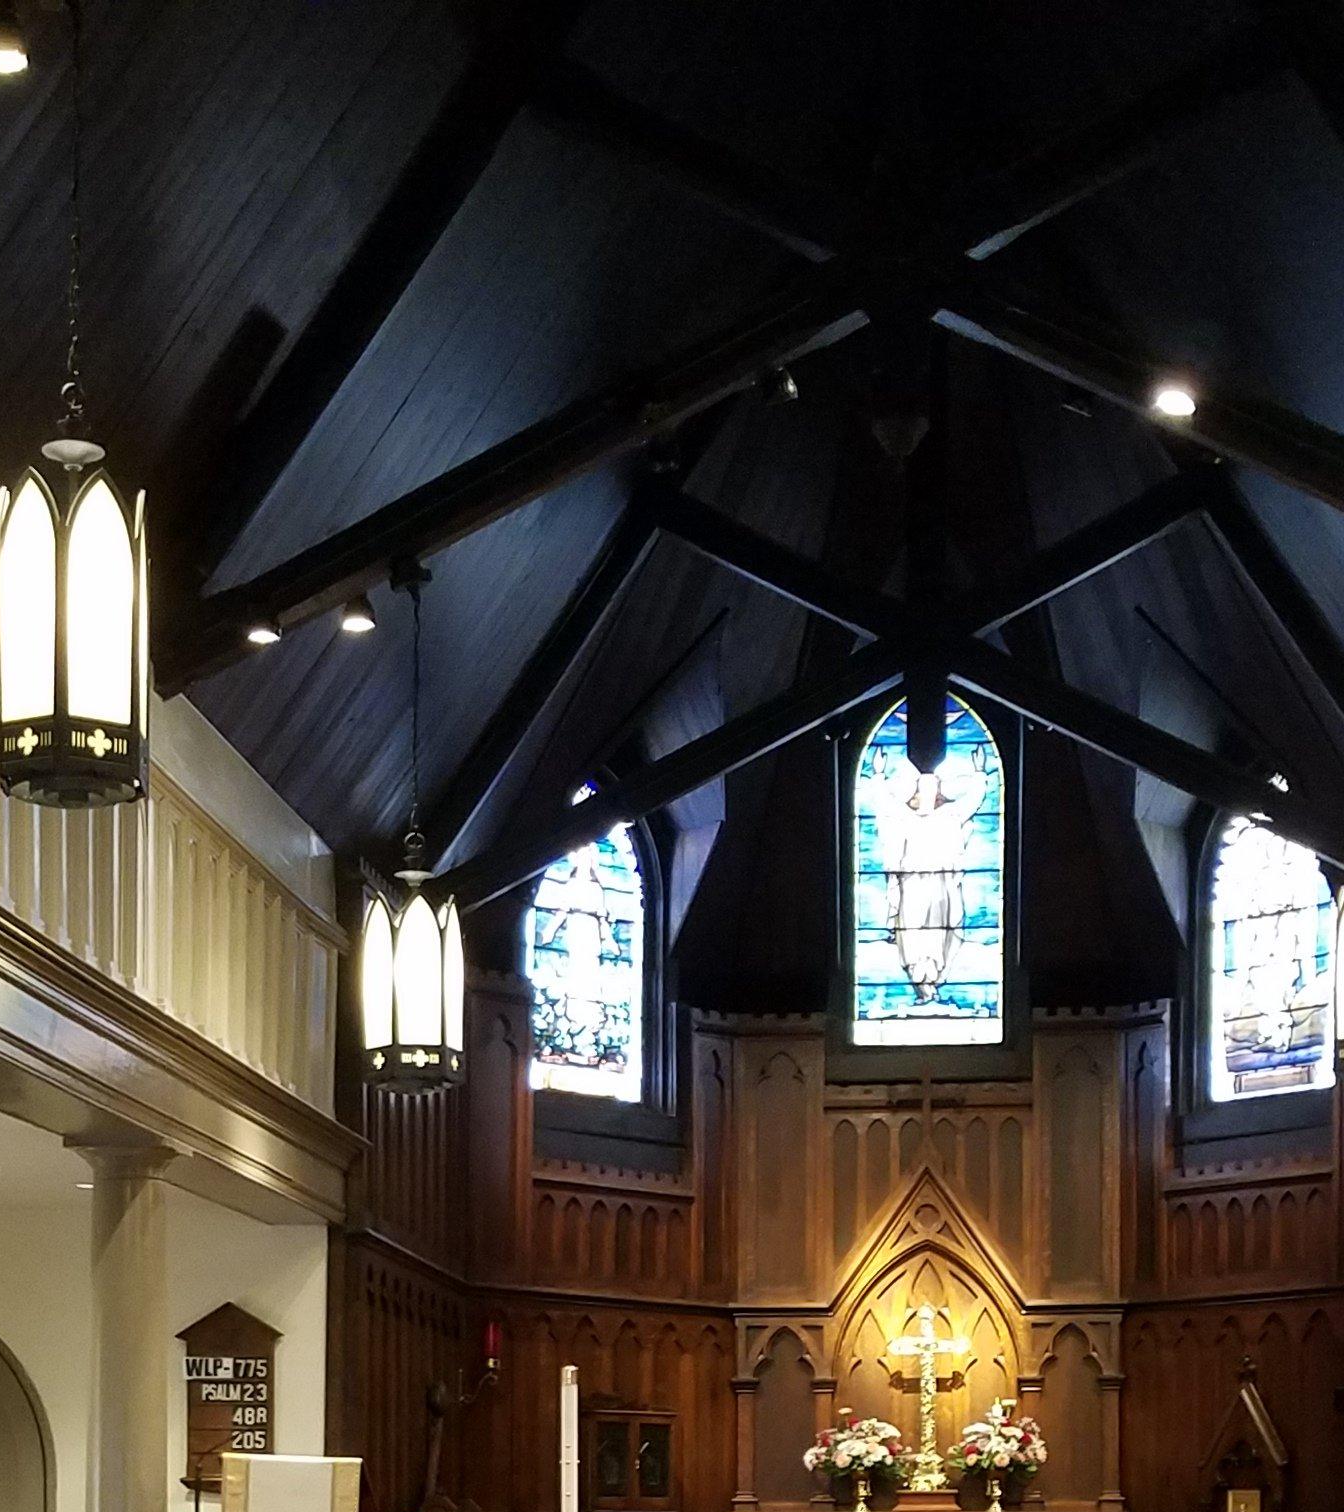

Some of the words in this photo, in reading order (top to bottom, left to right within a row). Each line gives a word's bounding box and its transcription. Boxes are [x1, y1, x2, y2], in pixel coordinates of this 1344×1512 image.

[236, 1359, 267, 1377] 775
[201, 1383, 241, 1401] PSALM
[243, 1383, 268, 1401] 23
[232, 1431, 266, 1449] 205
